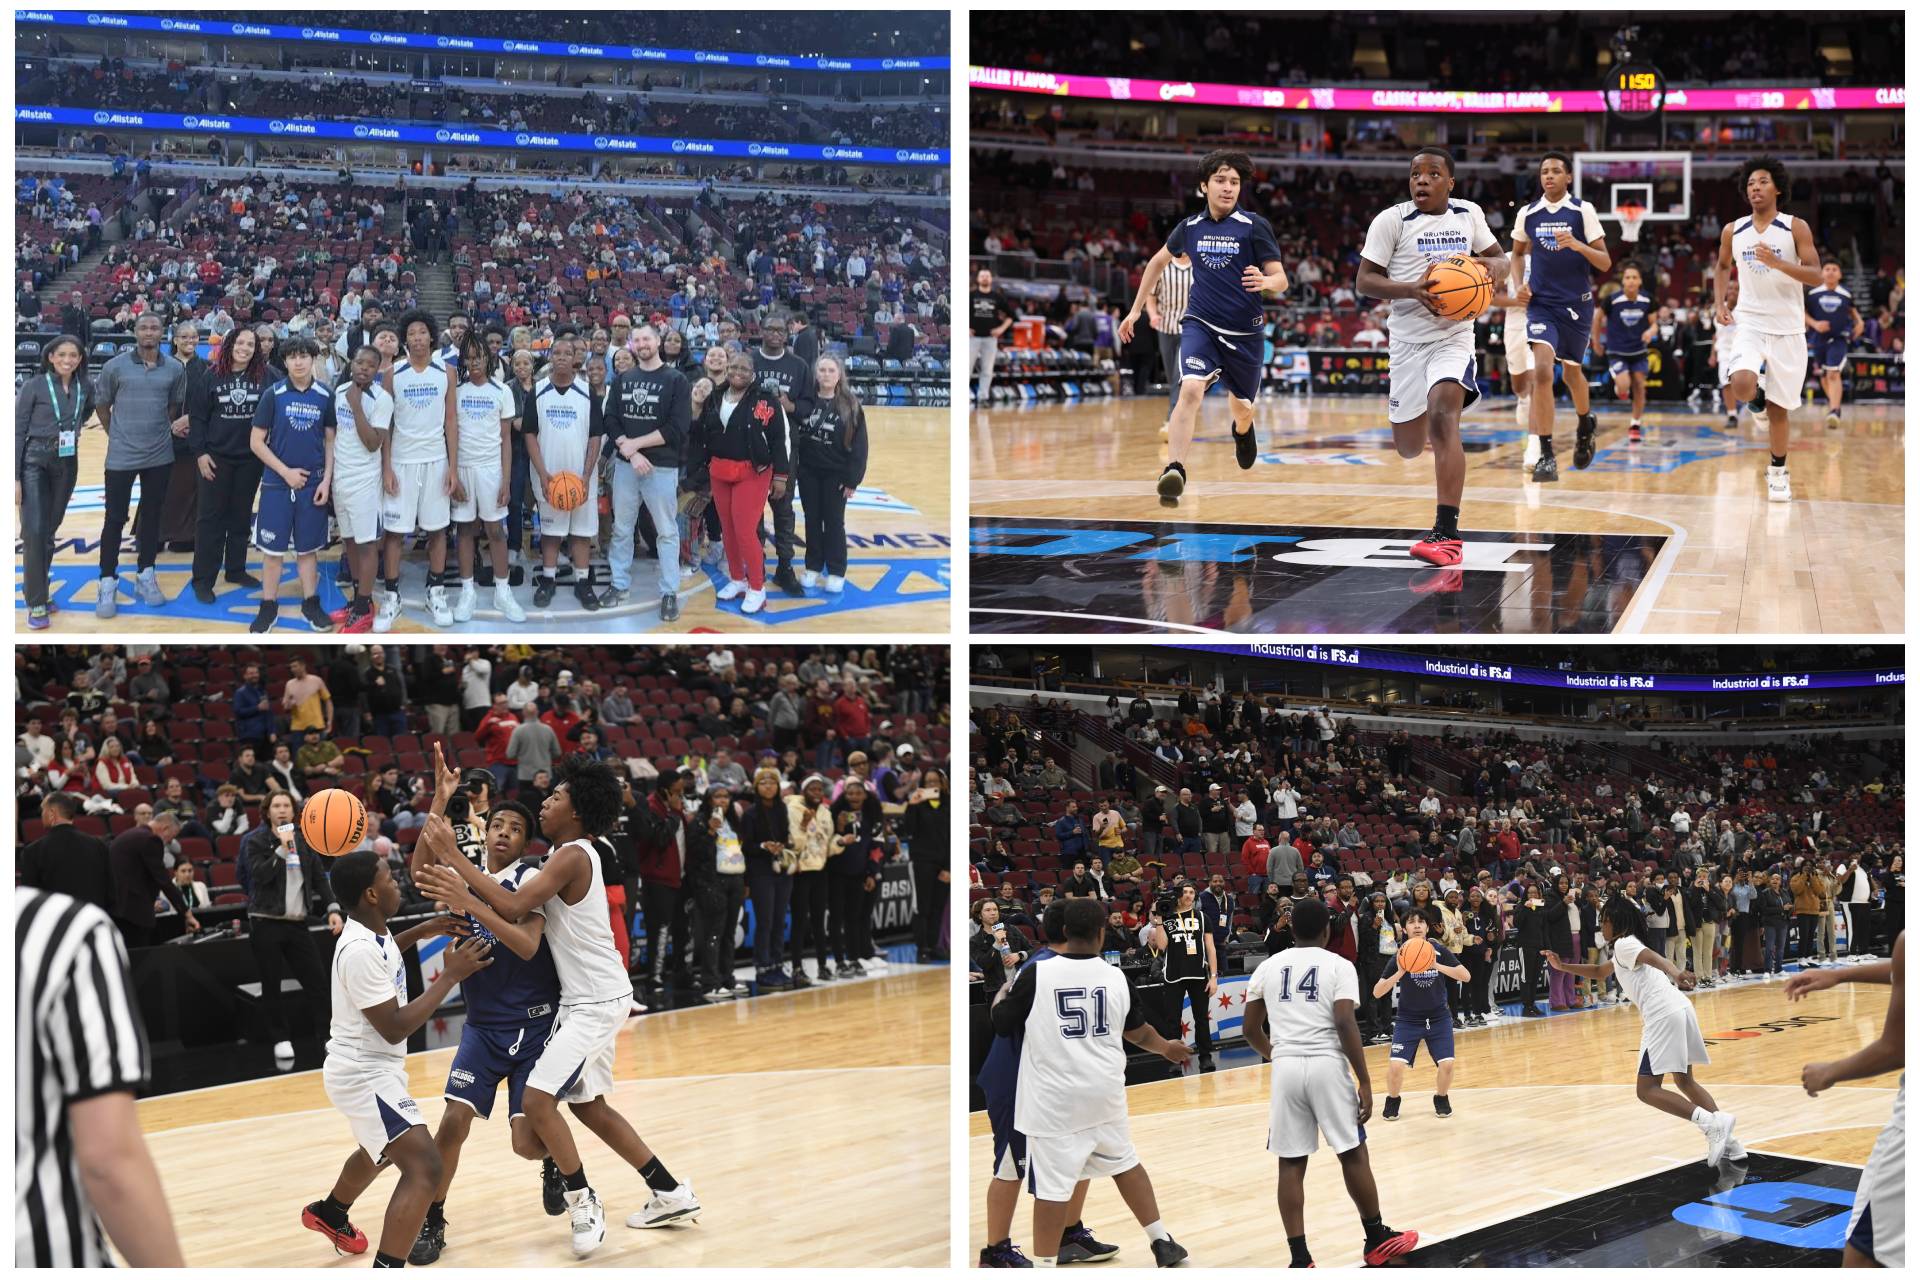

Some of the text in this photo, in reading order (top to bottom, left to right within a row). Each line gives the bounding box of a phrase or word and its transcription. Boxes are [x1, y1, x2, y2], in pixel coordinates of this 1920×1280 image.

[26, 12, 53, 21] Allstate
[100, 16, 127, 26] Allstate
[173, 22, 200, 31] Allstate
[244, 26, 270, 35] Allstate
[314, 31, 339, 40] Allstate
[382, 35, 407, 43] Allstate
[449, 39, 473, 48] Allstate
[514, 43, 538, 52] Allstate
[578, 46, 603, 55] Allstate
[643, 50, 666, 59] Allstate
[705, 54, 728, 62] Allstate
[767, 57, 790, 66] Allstate
[828, 60, 851, 69] Allstate
[894, 60, 920, 68] Allstate
[19, 109, 52, 120] Allstate
[109, 114, 143, 125] Allstate
[198, 119, 230, 129] Allstate
[283, 123, 315, 133] Allstate
[368, 128, 399, 138] Allstate
[449, 132, 480, 142] Allstate
[529, 136, 559, 146] Allstate
[607, 139, 636, 149] Allstate
[685, 142, 714, 152] Allstate
[761, 146, 789, 156] Allstate
[835, 149, 863, 159] Allstate
[909, 152, 939, 161] Allstate
[1197, 240, 1240, 255] BULLDOGS
[1417, 237, 1467, 252] BULLDOGS
[404, 386, 438, 398] BULLDOGS
[461, 399, 494, 409] BULLDOGS
[1307, 645, 1318, 659] ai
[1319, 647, 1328, 660] is
[1331, 648, 1359, 664] IFS.ai
[1426, 660, 1512, 679] Industrial ai is IFS.ai
[1567, 675, 1654, 688] Industrial ai is IFS.ai
[1713, 674, 1809, 689] Industrial ai is IFS.ai
[1278, 965, 1320, 1002] 14
[1054, 986, 1110, 1040] 51
